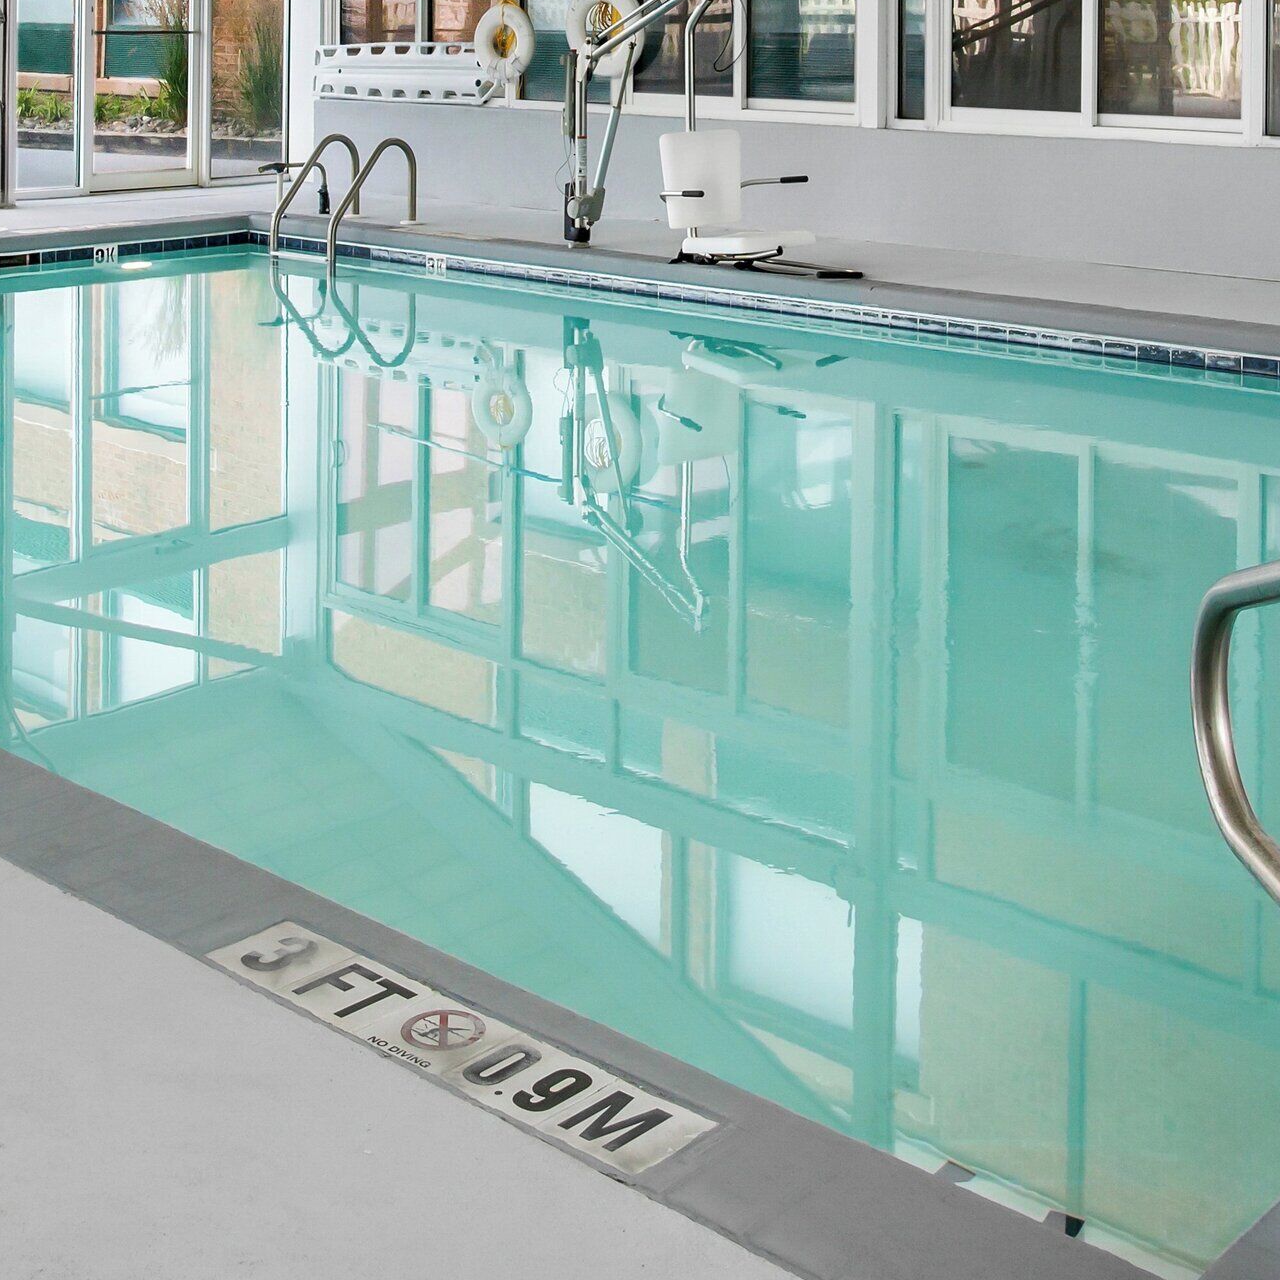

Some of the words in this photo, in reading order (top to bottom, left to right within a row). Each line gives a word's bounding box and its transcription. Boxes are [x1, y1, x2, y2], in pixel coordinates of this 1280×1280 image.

[241, 937, 318, 972] 3
[292, 963, 418, 1018] FT
[462, 1044, 674, 1152] 0.9M
[367, 1036, 388, 1046] NO
[388, 1046, 431, 1068] DIVING
